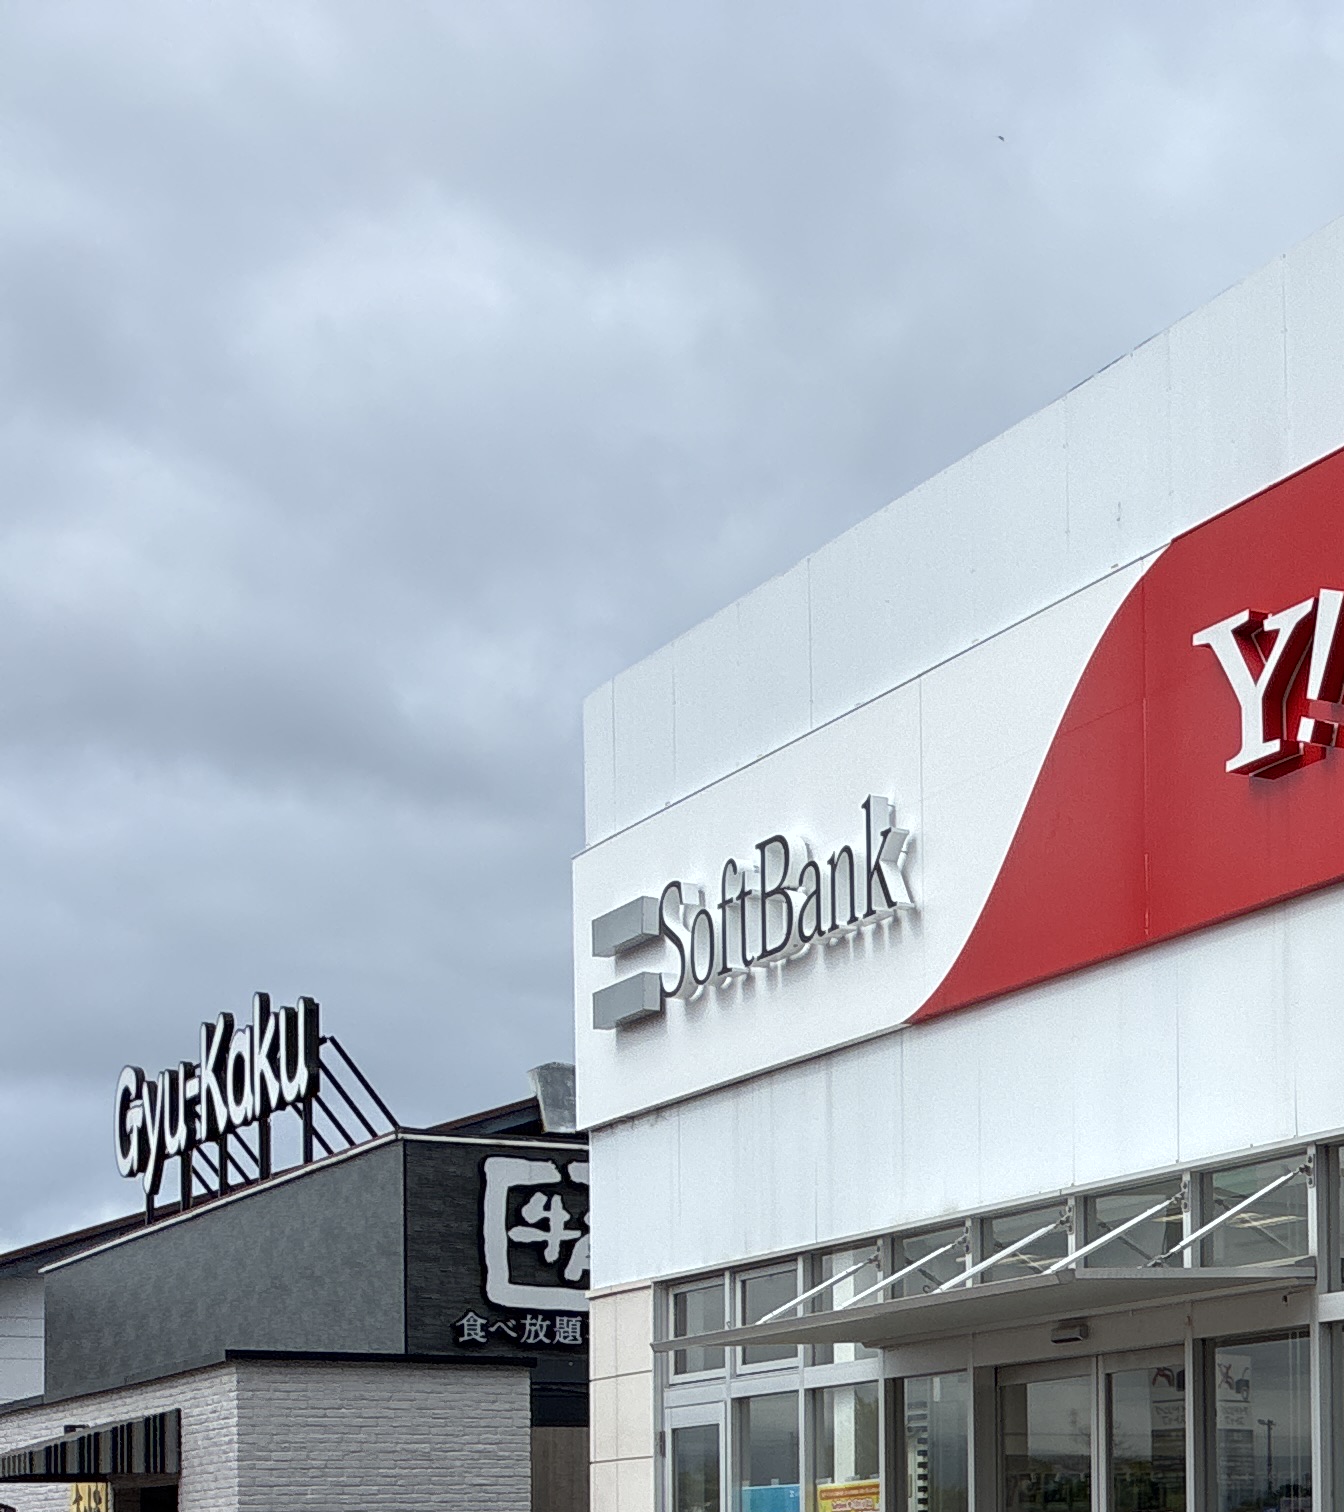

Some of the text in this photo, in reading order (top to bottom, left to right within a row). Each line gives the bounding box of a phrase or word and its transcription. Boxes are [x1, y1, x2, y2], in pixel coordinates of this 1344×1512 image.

[658, 793, 908, 999] SoftBank
[113, 991, 319, 1196] Gyu-Kaku
[456, 1311, 584, 1346] 食べ放題
